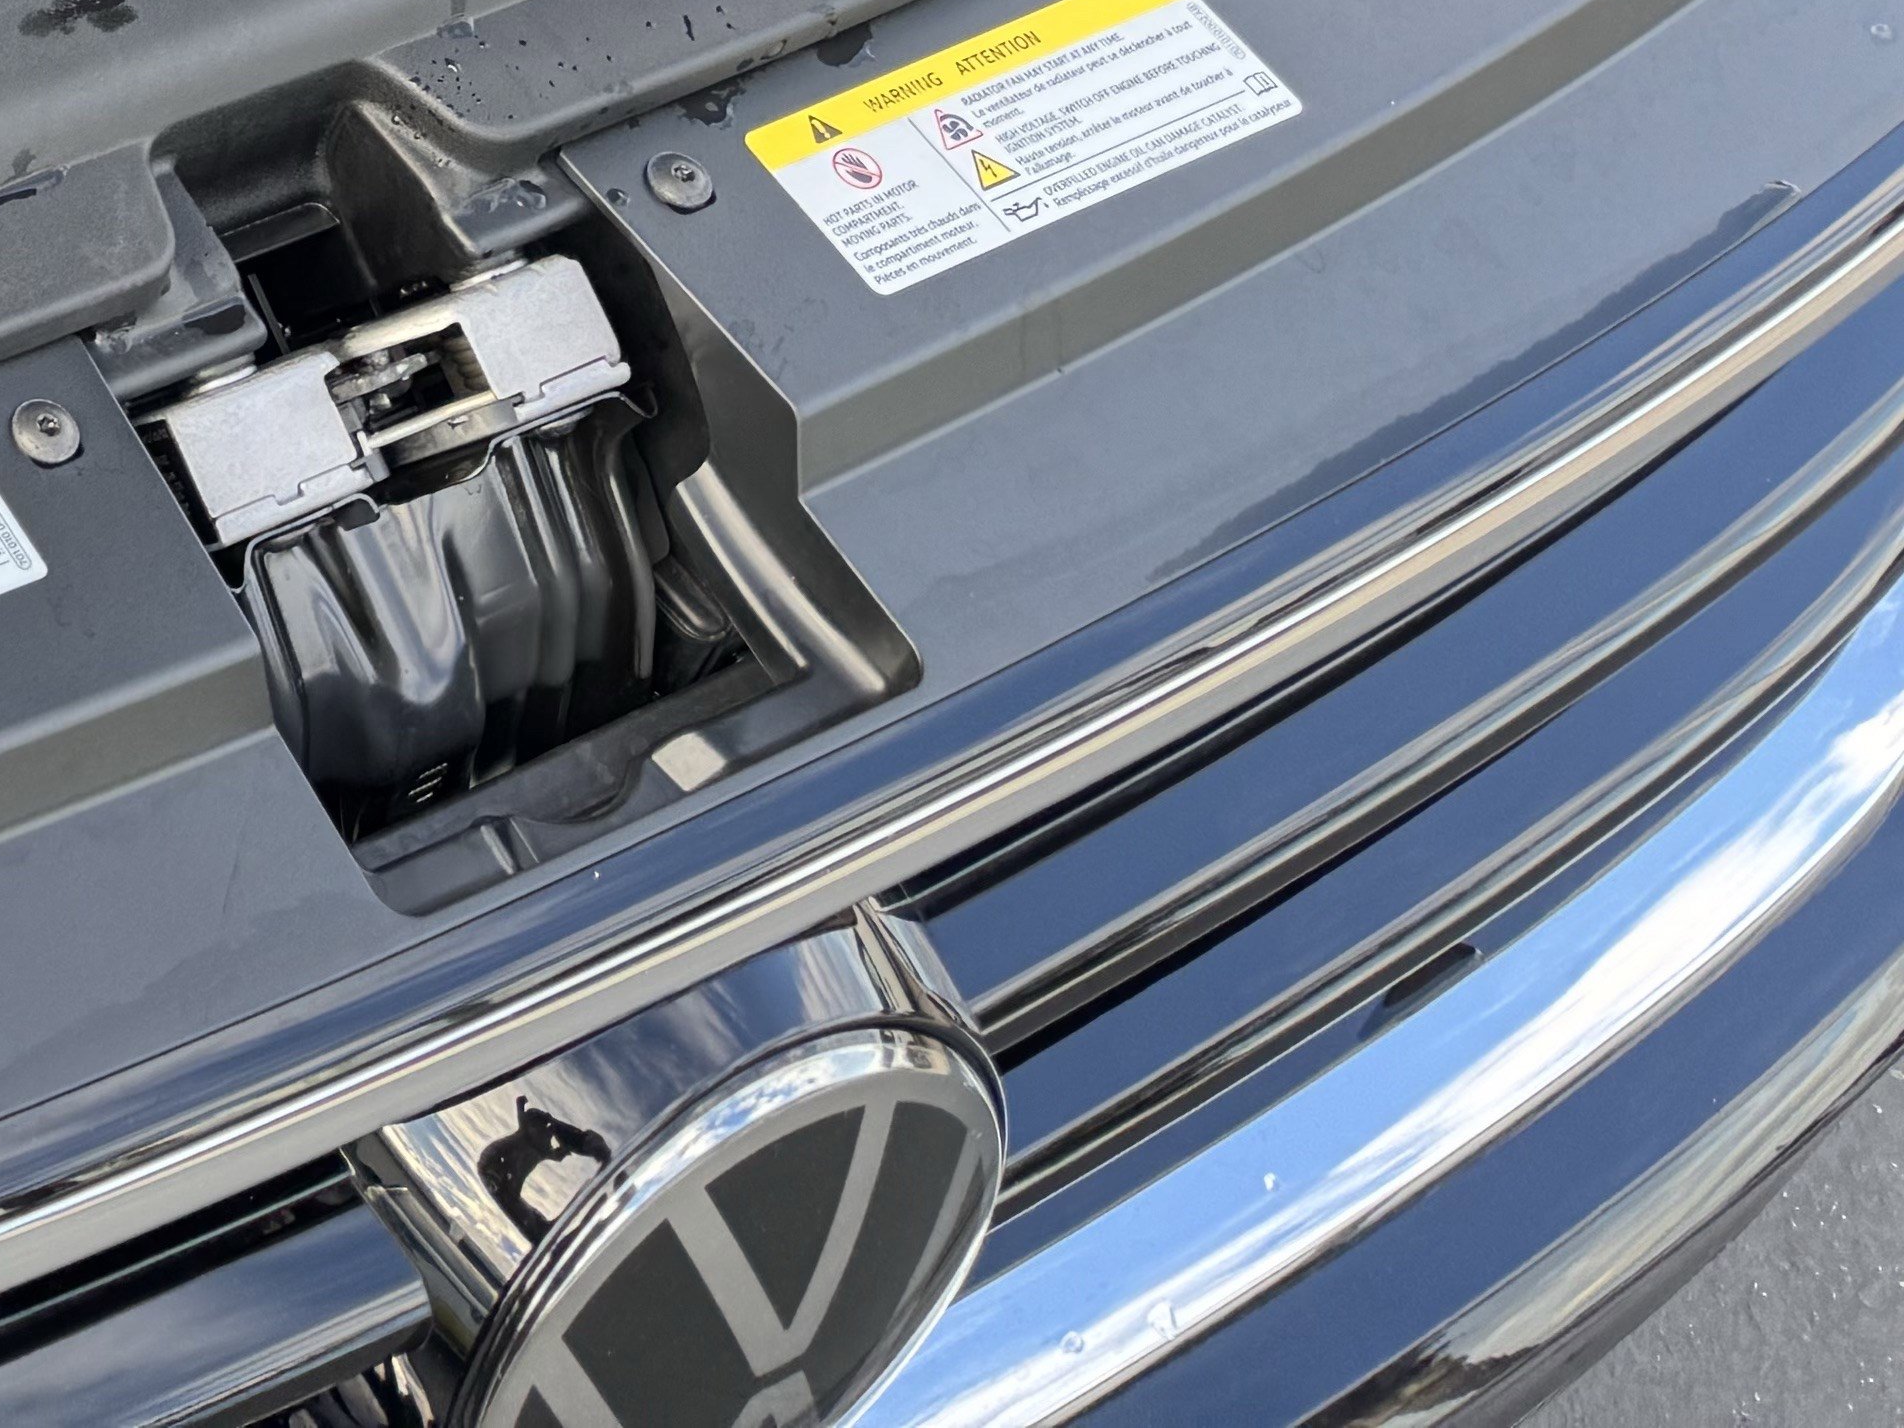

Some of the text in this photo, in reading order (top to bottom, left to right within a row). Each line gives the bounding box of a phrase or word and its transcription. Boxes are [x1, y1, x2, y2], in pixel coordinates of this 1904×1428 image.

[863, 30, 1042, 113] WARNING ATTENTION
[961, 79, 1006, 106] RADIATOR
[1006, 73, 1026, 88] FAN
[1024, 66, 1043, 80] MAY
[1042, 55, 1070, 72] START
[1070, 48, 1082, 60] AT
[1081, 40, 1101, 55] ANY
[971, 21, 1192, 118] Le ventilateur de radiateur peut se déclencher à tout
[995, 127, 1019, 143] HIGH
[1058, 97, 1094, 117] SWITCH
[1093, 89, 1110, 102] OFF
[1109, 73, 1144, 95] ENGINE
[1142, 61, 1177, 82] BEFORE
[1175, 43, 1221, 67] TOUCHING
[1004, 131, 1049, 153] IGNITION
[1015, 149, 1045, 166] Haute
[1082, 119, 1111, 136] arrêter
[1111, 116, 1121, 126] le
[1122, 102, 1154, 120] moteur
[1154, 90, 1180, 107] avant
[1179, 85, 1192, 95] de
[1191, 73, 1225, 90] toucher
[1224, 67, 1234, 76] à
[1043, 166, 1097, 196] OVERFILLED
[1096, 151, 1131, 173] ENGINE
[1129, 143, 1146, 158] OIL
[1144, 135, 1166, 151] CAN
[1164, 122, 1202, 143] DAMAGE
[1053, 178, 1111, 208] Remplissage
[1109, 161, 1144, 183] excessif
[1173, 132, 1219, 159] dangereux
[1219, 122, 1240, 138] pour
[1239, 117, 1249, 126] le
[823, 179, 919, 226] HOT PARTS IN MOTOR
[832, 202, 905, 237] COMPARTMENT.
[843, 212, 912, 247] MOVING PARTS.
[854, 202, 982, 262] Composants très chauds dans
[864, 220, 979, 273] le compartiment moteur.
[874, 236, 978, 284] Pièces en mouvement.
